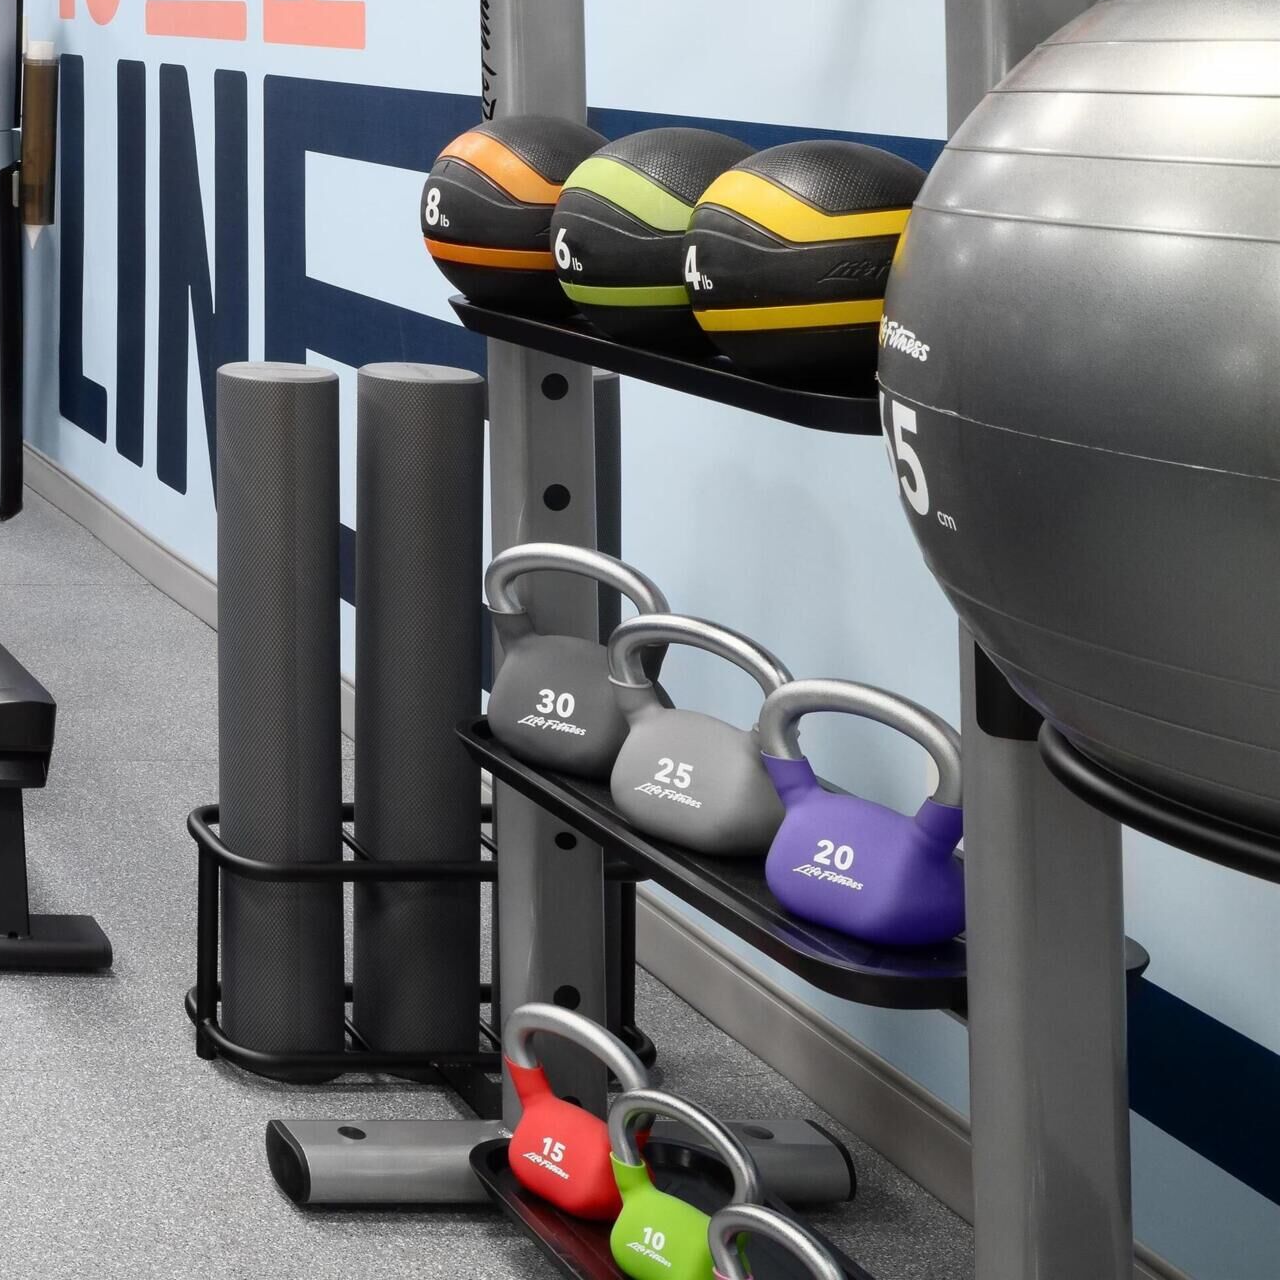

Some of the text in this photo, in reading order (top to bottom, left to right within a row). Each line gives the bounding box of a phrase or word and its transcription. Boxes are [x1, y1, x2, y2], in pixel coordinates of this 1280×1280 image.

[937, 511, 957, 531] cm
[536, 689, 575, 718] 30
[654, 757, 694, 789] 25
[813, 839, 854, 871] 20
[542, 1137, 566, 1163] 15
[643, 1227, 666, 1251] 10
